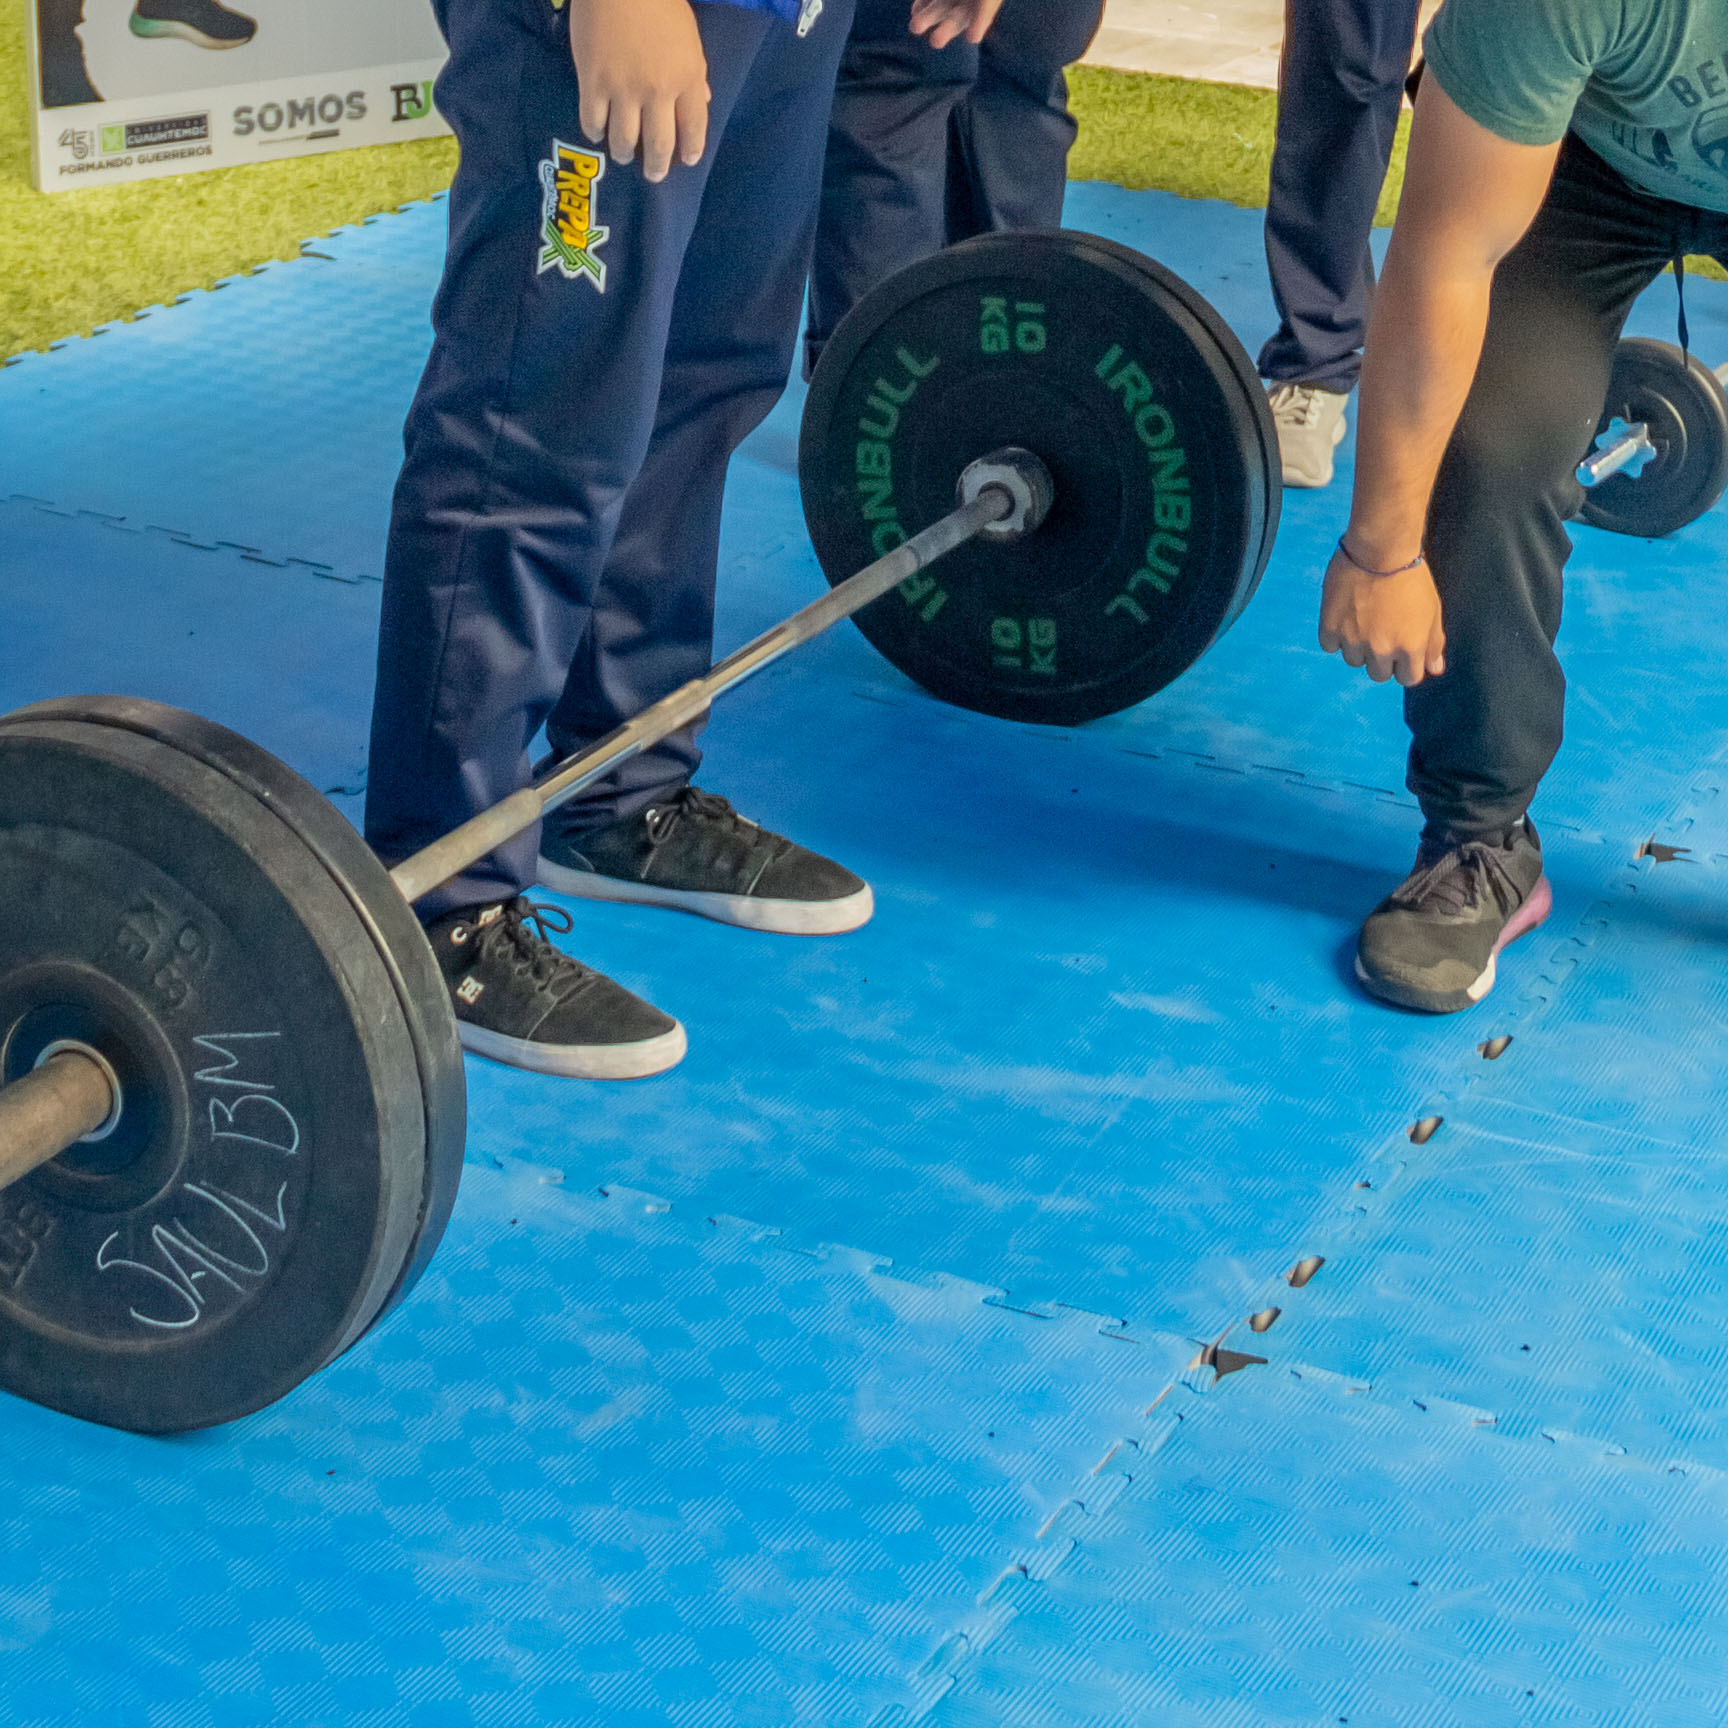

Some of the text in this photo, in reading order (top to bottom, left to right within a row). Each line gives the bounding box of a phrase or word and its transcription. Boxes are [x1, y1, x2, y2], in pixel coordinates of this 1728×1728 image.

[58, 145, 213, 176] FORMANDO GUERREROS
[233, 90, 367, 136] SOMOS
[556, 147, 600, 249] PREPA
[1094, 344, 1193, 624] IRONBULL
[193, 1032, 299, 1155] BM
